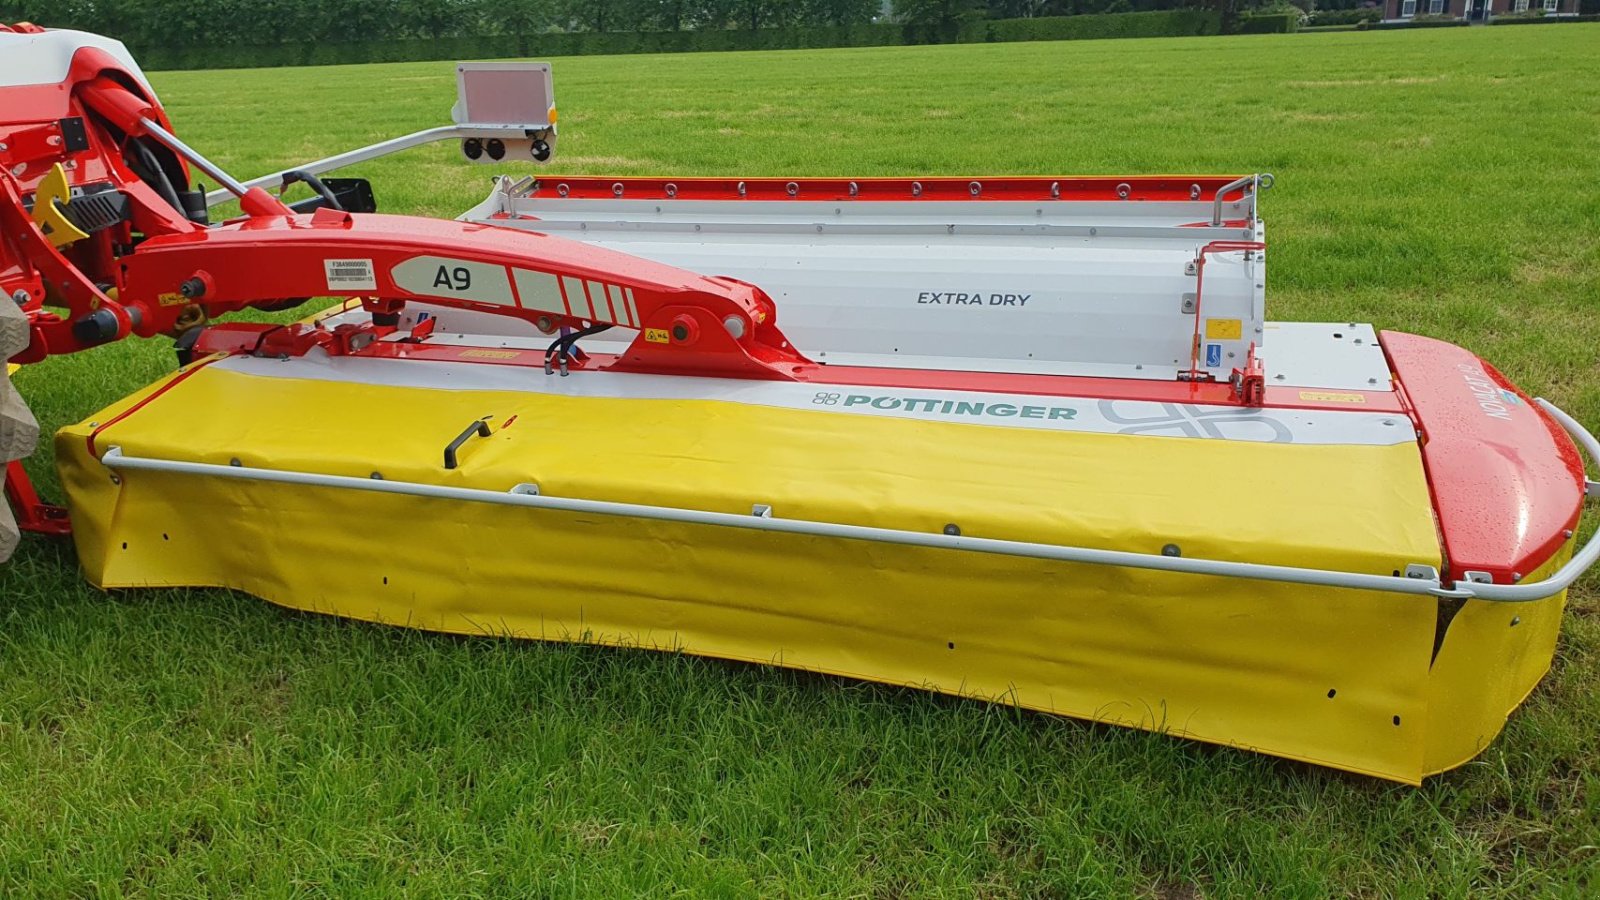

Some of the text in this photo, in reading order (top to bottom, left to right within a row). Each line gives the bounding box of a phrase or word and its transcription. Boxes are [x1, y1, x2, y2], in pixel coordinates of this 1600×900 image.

[433, 265, 471, 290] A9
[918, 292, 1031, 306] EXTRA DRY
